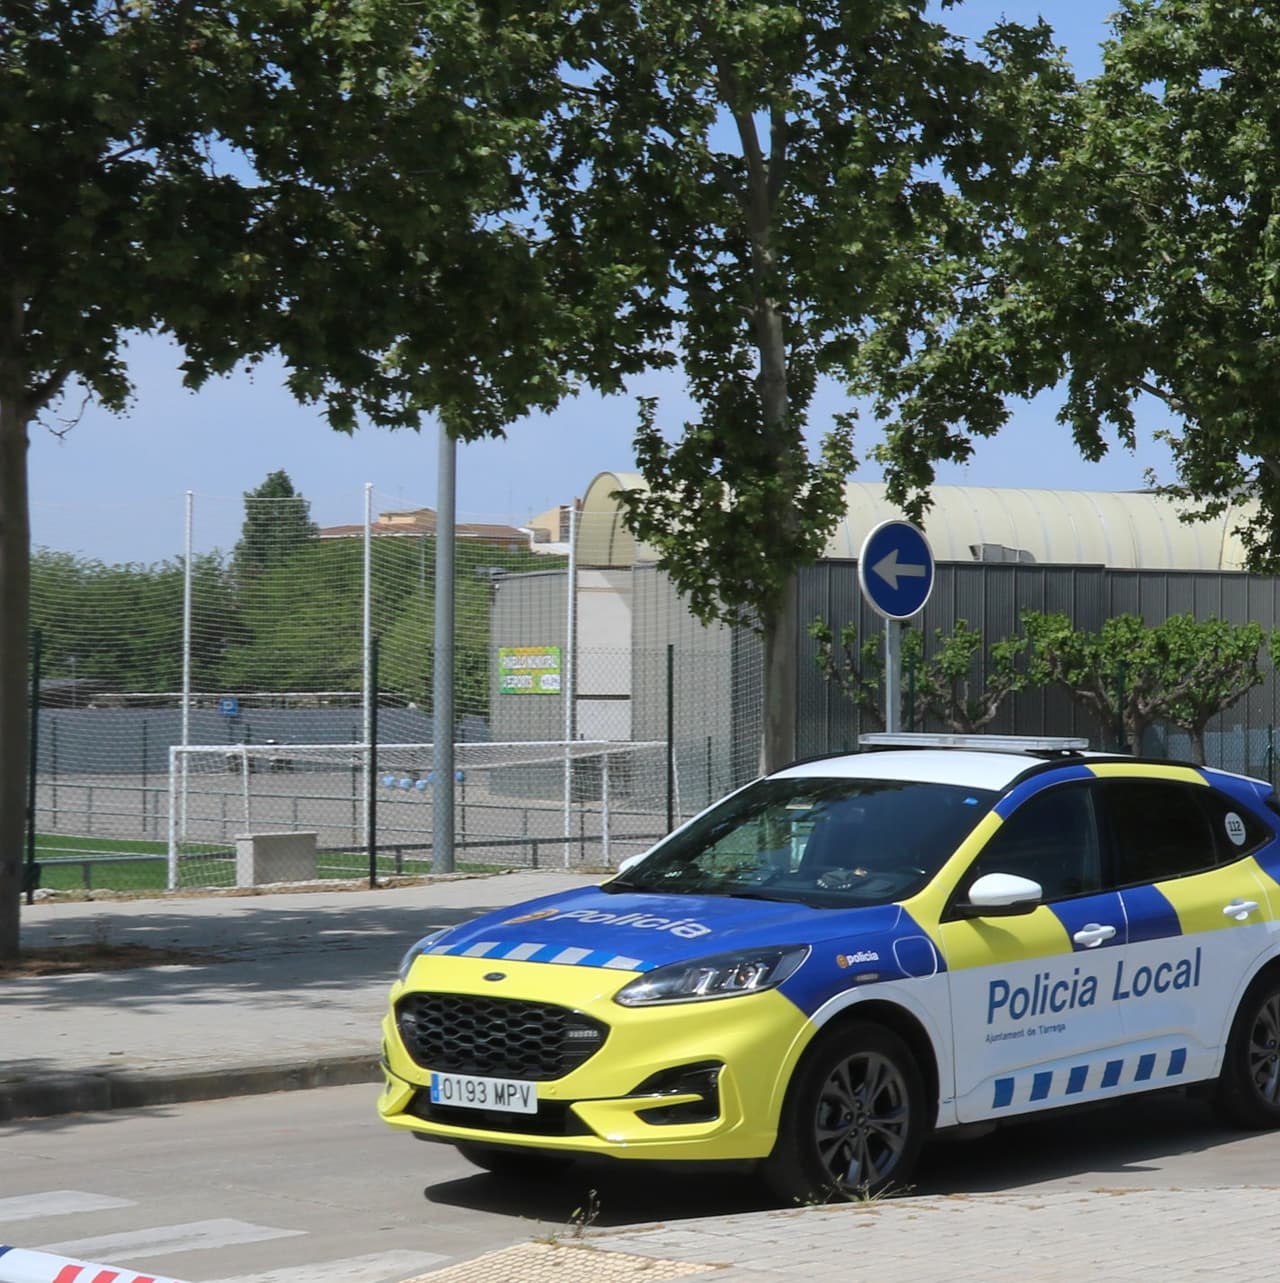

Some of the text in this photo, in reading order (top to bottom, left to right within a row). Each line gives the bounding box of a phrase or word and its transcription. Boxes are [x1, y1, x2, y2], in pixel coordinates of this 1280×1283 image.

[1228, 820, 1243, 832] 112
[987, 947, 1202, 1025] Policia Local
[1027, 1027, 1036, 1037] de
[443, 1078, 530, 1108] 0193 MPV
